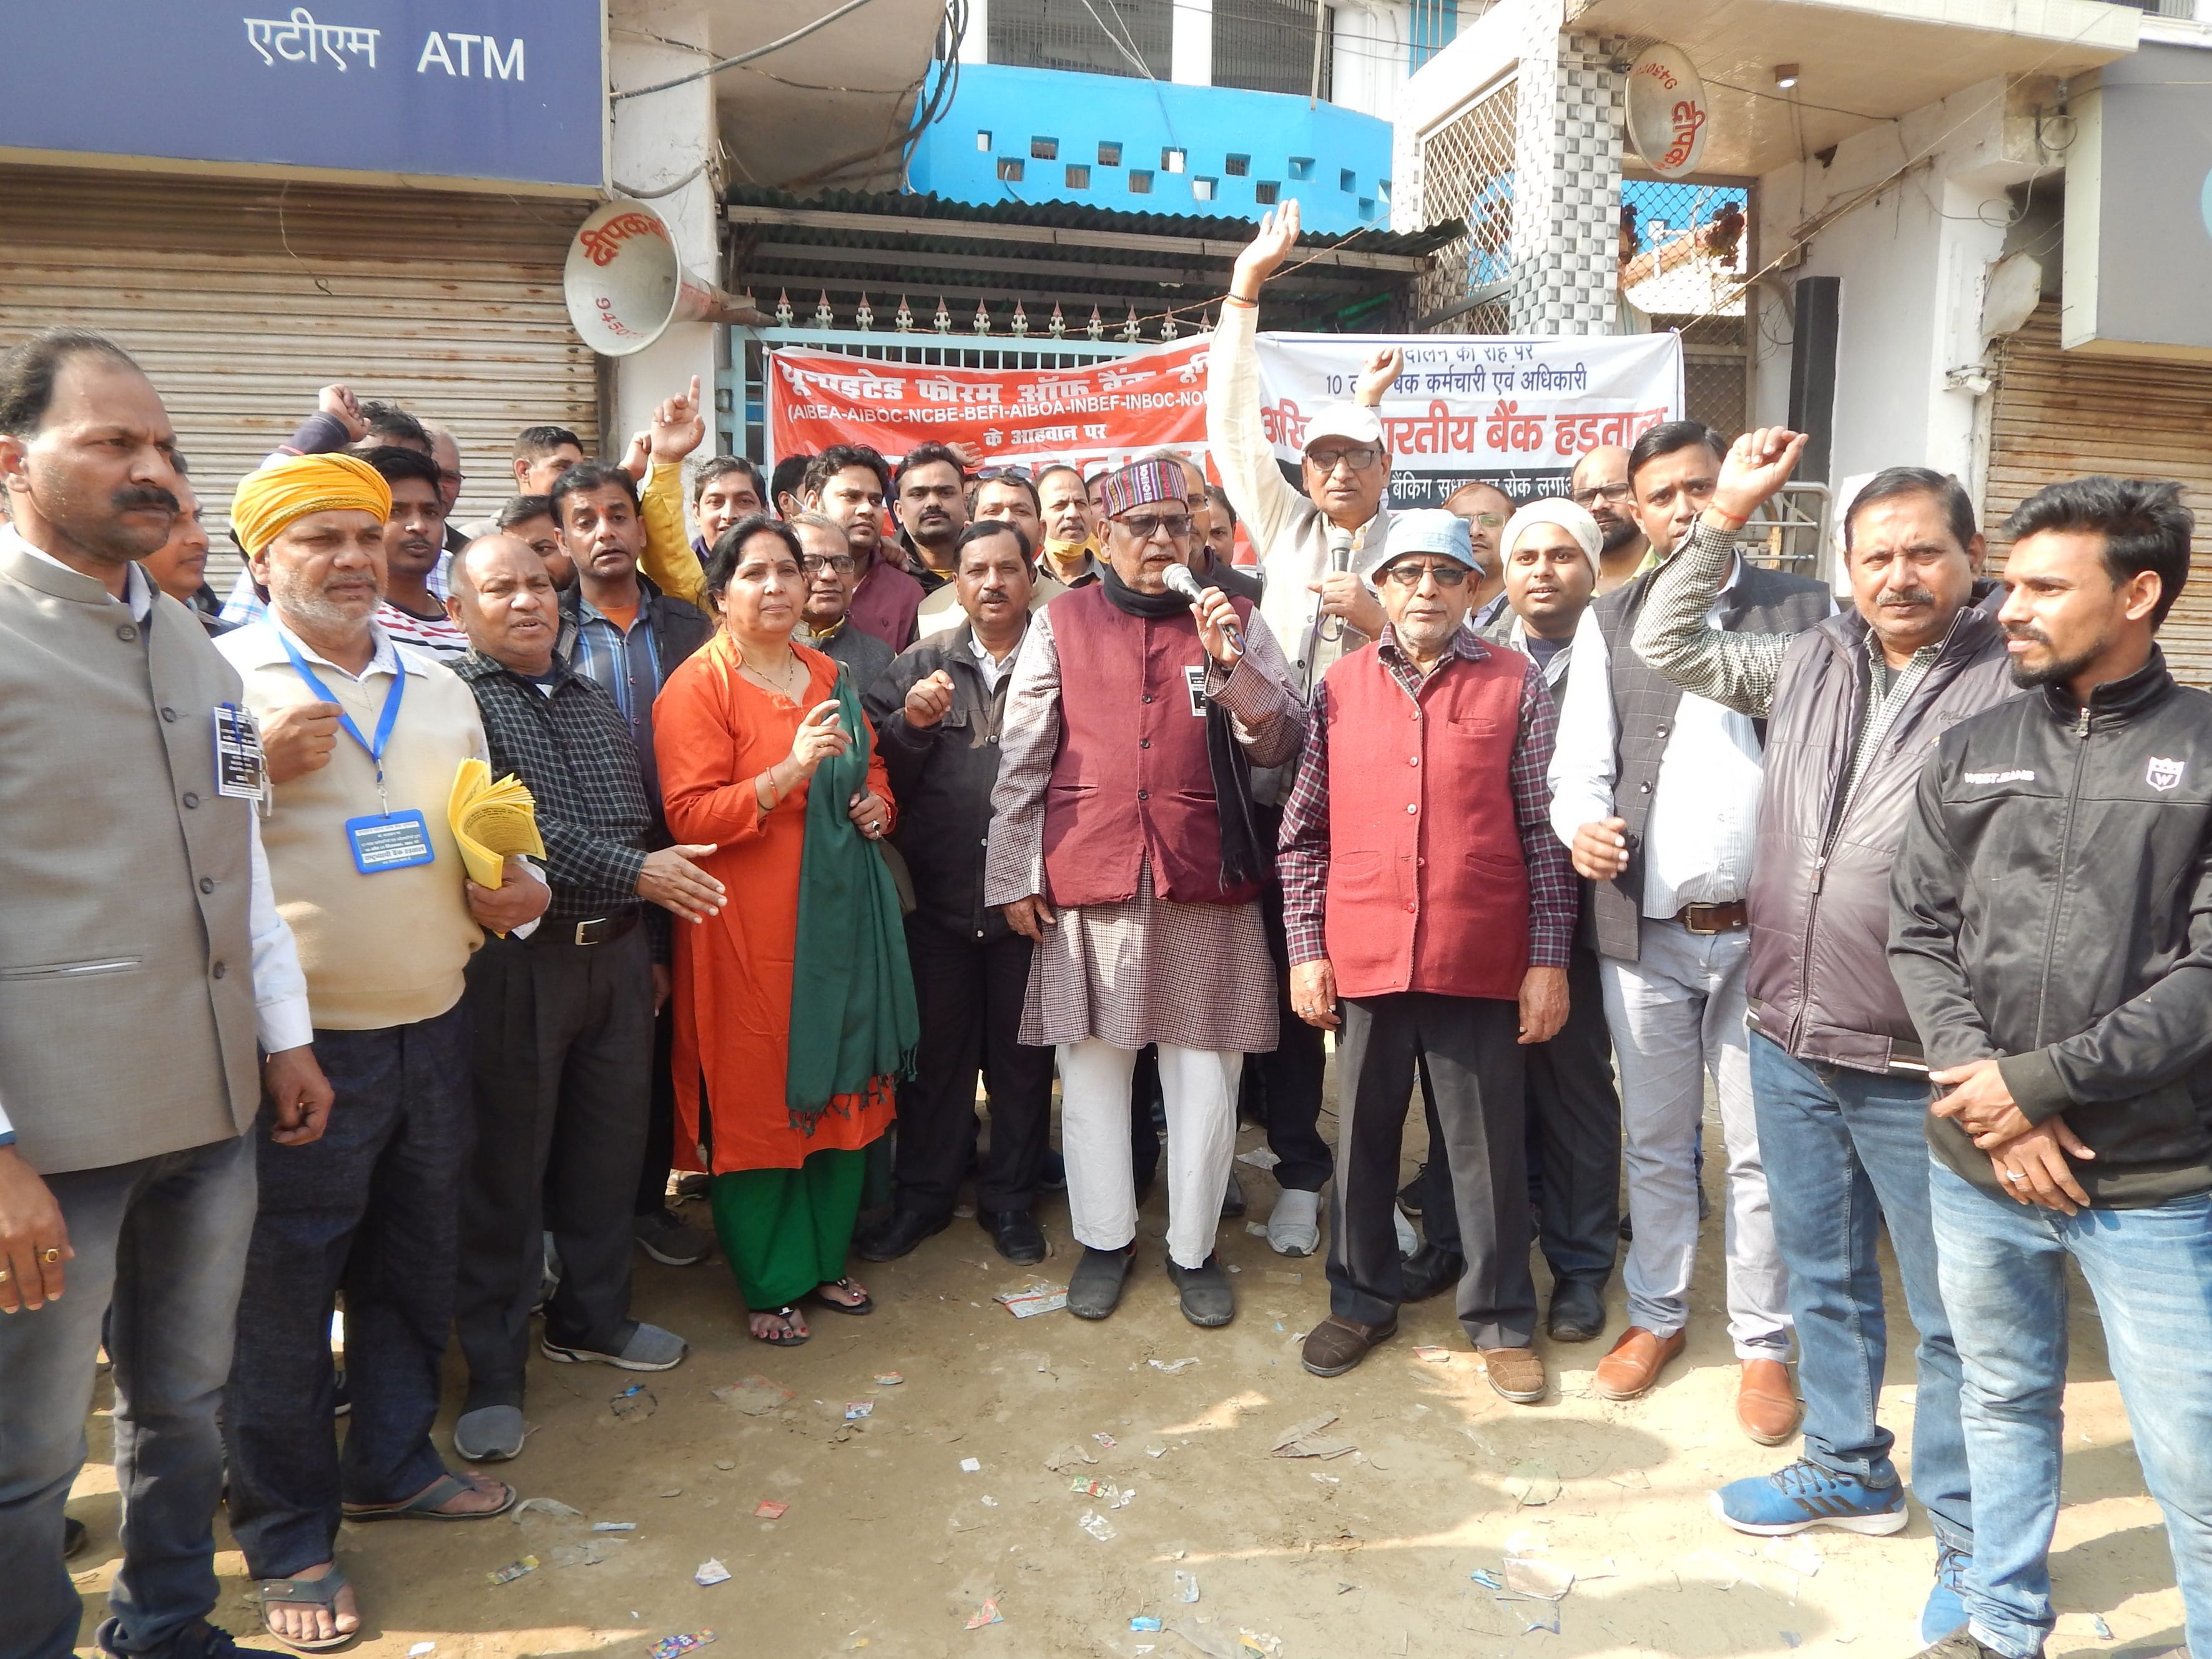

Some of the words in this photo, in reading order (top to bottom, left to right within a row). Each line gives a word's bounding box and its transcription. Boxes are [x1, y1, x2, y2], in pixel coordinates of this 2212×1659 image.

[243, 7, 380, 72] एटीएम
[416, 31, 524, 81] ATM
[915, 375, 1003, 403] फोरम
[1327, 375, 1342, 395] 10
[1425, 364, 1486, 393] कर्मचारी
[1492, 365, 1515, 395] एवं
[1521, 362, 1586, 391] अधिकारी
[983, 428, 1004, 446] के
[1083, 424, 1107, 440] पर
[1487, 399, 1546, 453] बैंक
[1503, 470, 1531, 497] रोक
[2155, 772, 2174, 785] W
